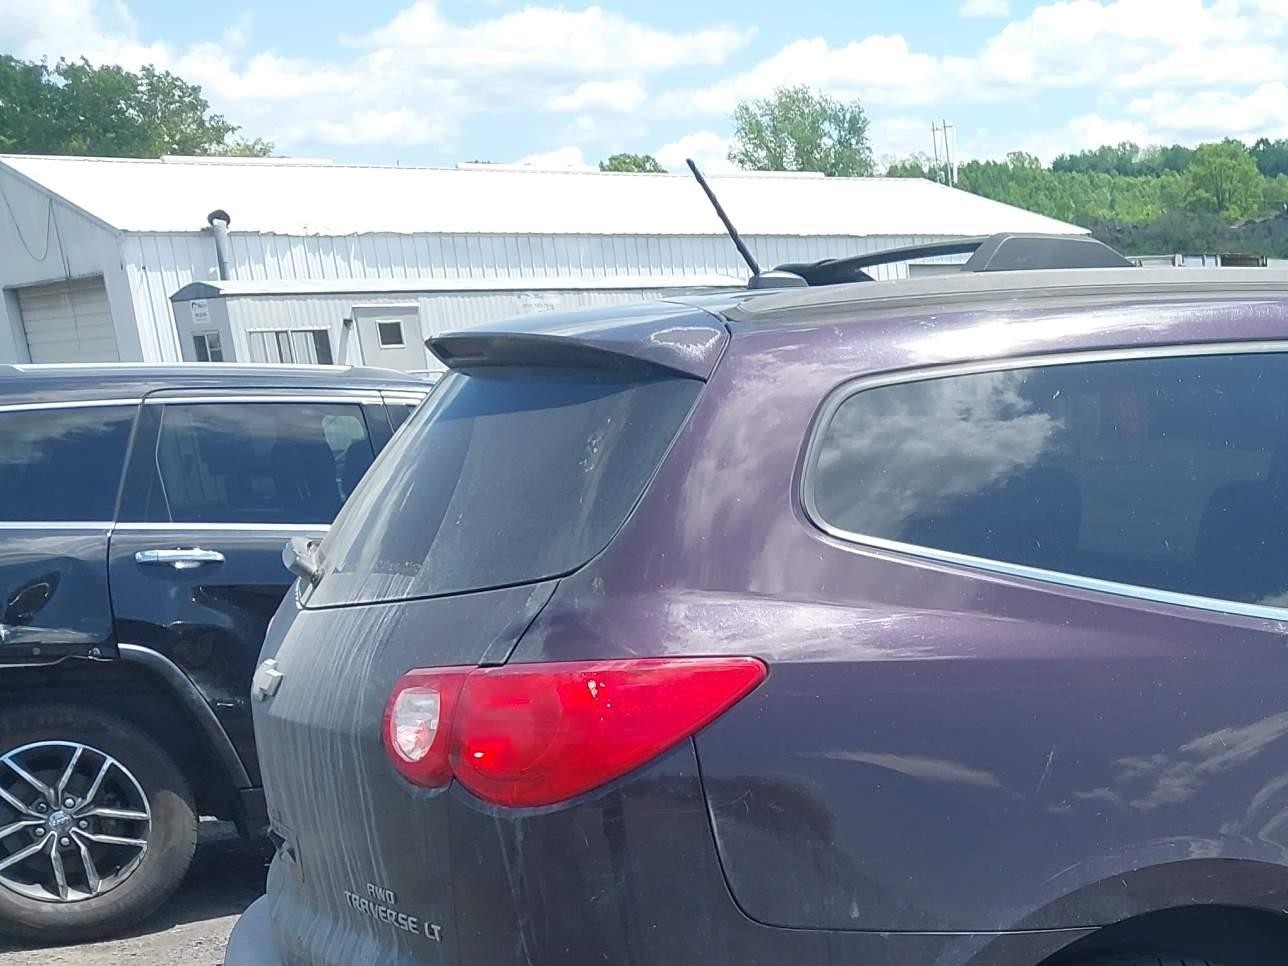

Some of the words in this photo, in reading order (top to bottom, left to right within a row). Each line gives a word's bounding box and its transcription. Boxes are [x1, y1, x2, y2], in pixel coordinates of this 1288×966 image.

[366, 882, 395, 905] AWD
[344, 891, 420, 934] TRAVERSE
[424, 921, 441, 941] LT
